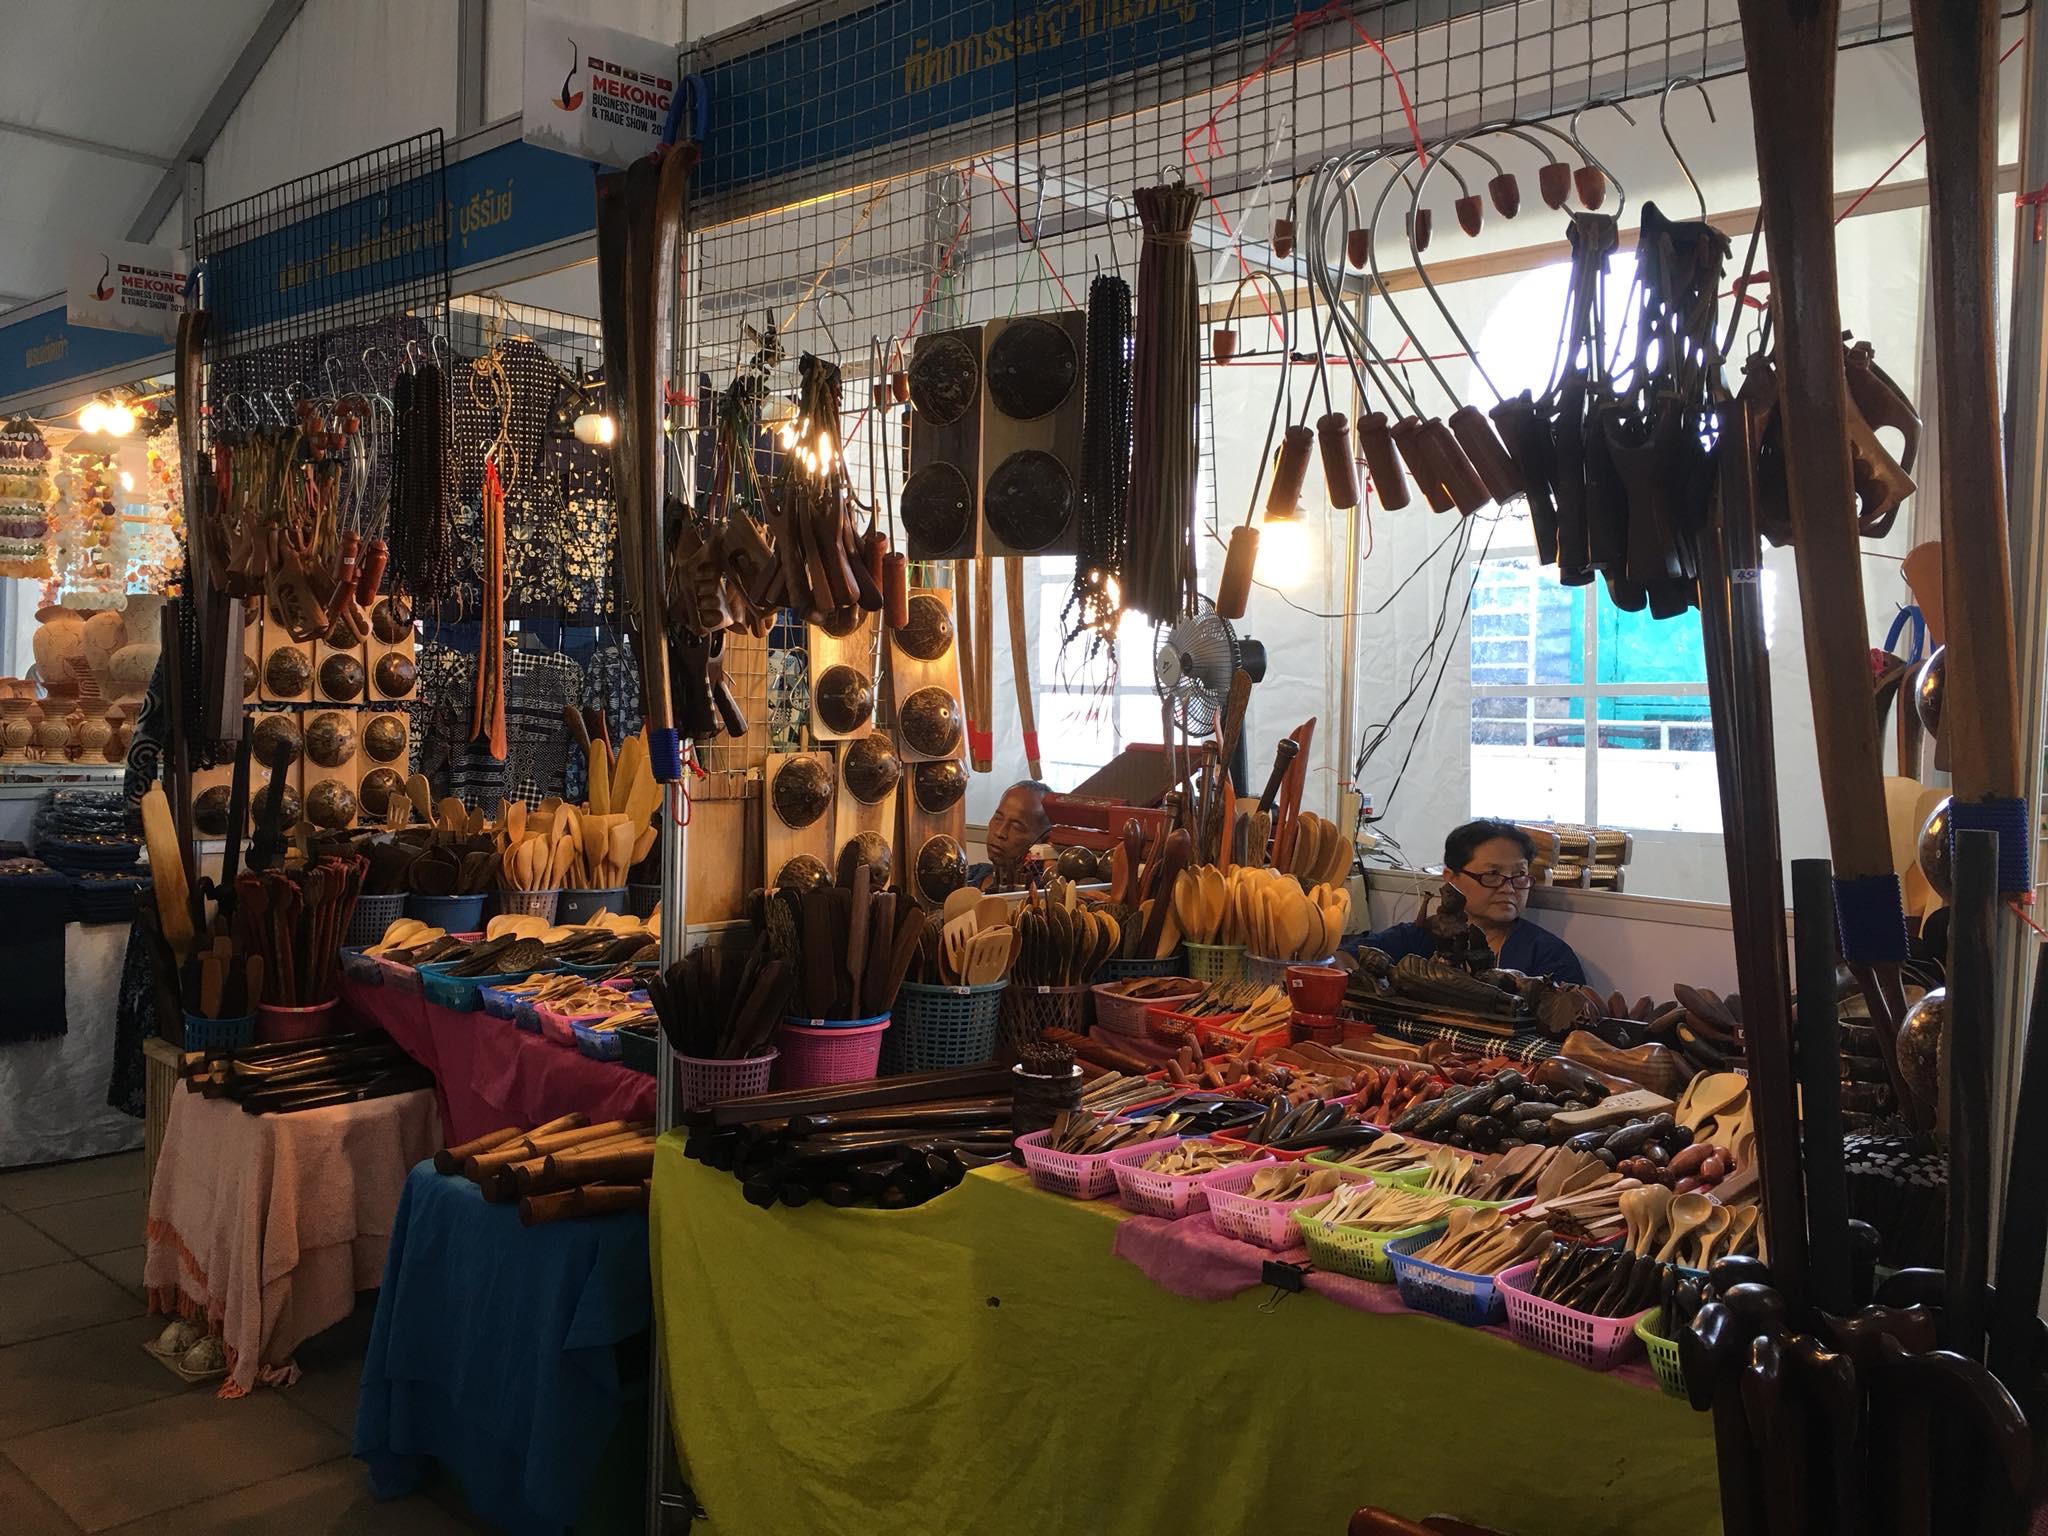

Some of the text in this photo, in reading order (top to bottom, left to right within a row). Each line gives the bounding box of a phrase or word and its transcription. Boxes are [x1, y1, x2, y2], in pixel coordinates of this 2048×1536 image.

[592, 74, 671, 112] MEKONG
[592, 93, 657, 121] BUSINESS FORUM
[592, 107, 598, 118] &
[600, 108, 625, 126] TRADE
[625, 116, 648, 133] SHOW
[460, 177, 513, 249] บุรีรัมย์
[121, 287, 175, 302] BUSINESS FORUM
[122, 275, 185, 295] MEKONG
